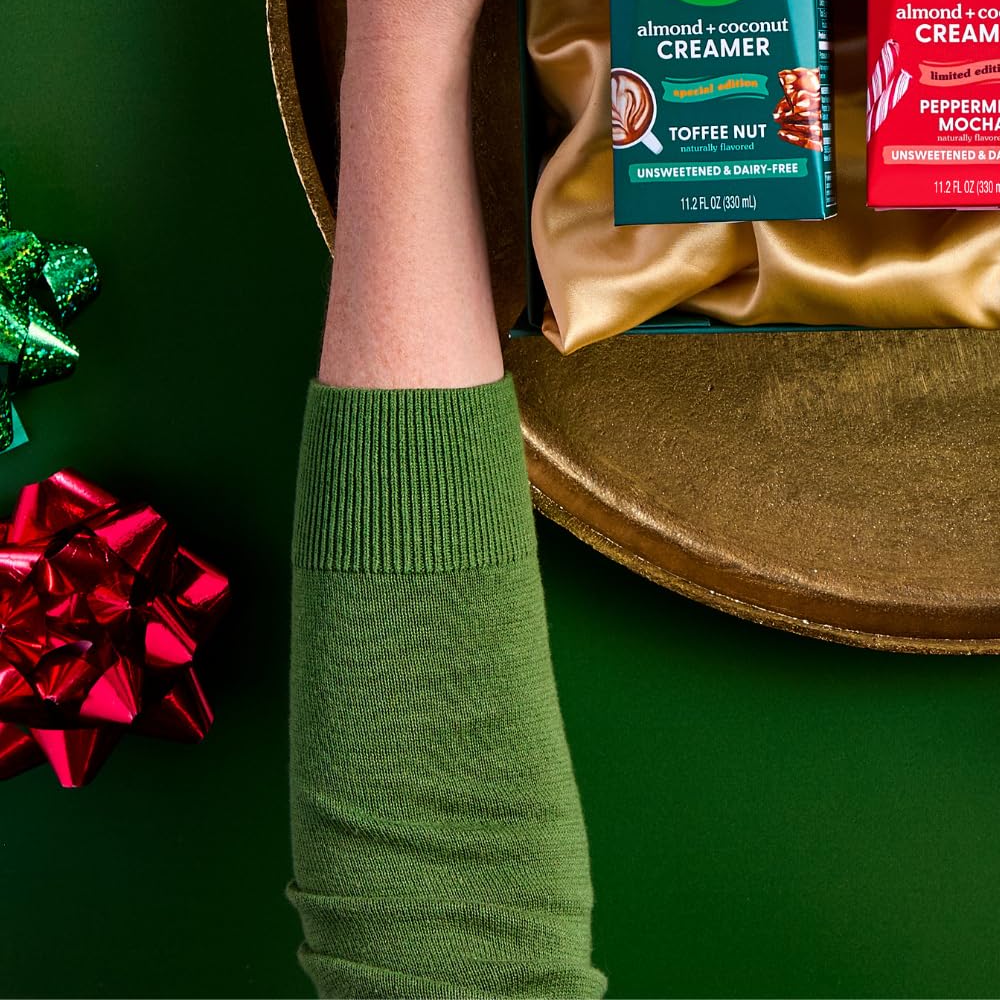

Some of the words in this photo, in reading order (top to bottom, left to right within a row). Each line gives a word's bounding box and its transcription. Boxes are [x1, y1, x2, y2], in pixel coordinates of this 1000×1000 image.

[896, 2, 961, 19] almond
[637, 19, 702, 37] almond
[719, 18, 788, 34] coconut
[657, 38, 770, 60] CREAMER
[931, 69, 971, 81] limited
[673, 84, 713, 98] special
[717, 78, 758, 91] edition
[669, 125, 728, 141] TOFFEE
[734, 124, 767, 139] NUT
[937, 134, 972, 142] naturally
[680, 144, 718, 153] naturally
[720, 142, 754, 151] flavored
[891, 151, 975, 160] UNSWEETENED
[978, 151, 986, 160] &
[637, 166, 720, 178] UNSWEETENED
[723, 167, 731, 175] &
[734, 163, 798, 175] DAIRY-FREE
[934, 181, 951, 193] 11.2
[953, 181, 962, 193] FL
[964, 181, 974, 193] OZ
[976, 180, 994, 194] (330
[680, 198, 697, 210] 11.2
[700, 197, 709, 209] FL
[710, 197, 721, 209] OZ
[723, 196, 740, 210] (330
[742, 195, 756, 210] mL)
